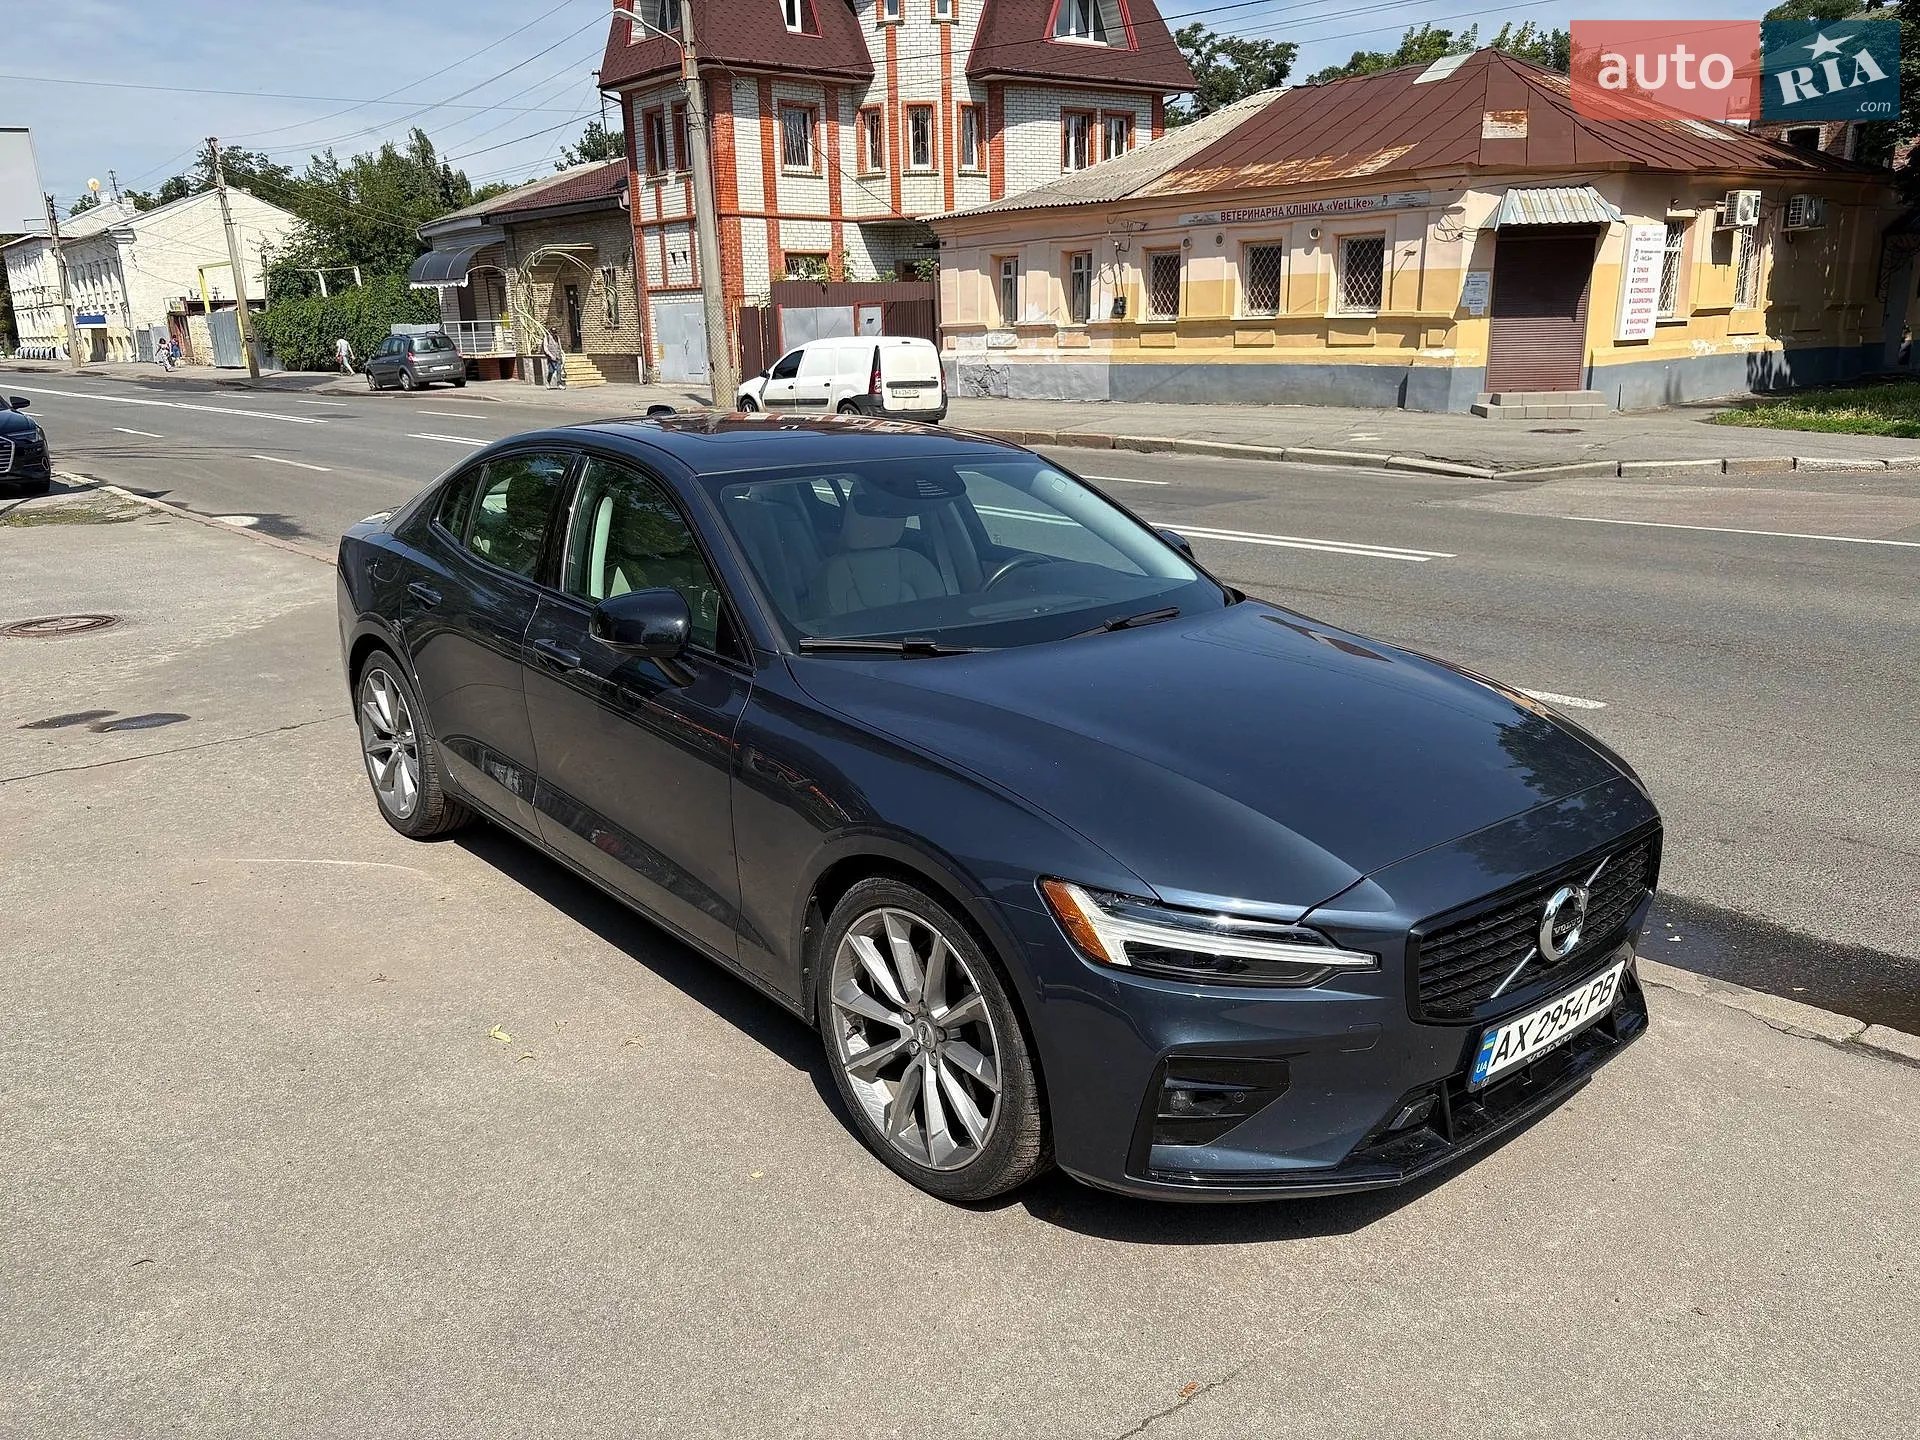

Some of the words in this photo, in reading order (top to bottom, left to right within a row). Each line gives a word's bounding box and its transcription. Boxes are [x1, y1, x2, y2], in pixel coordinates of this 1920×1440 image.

[1220, 205, 1284, 221] ВЕТЕРИНАРНА
[1286, 202, 1324, 215] КЛІНІКА
[1326, 198, 1374, 210] «VetLike»
[1492, 1018, 1535, 1066] AX
[1531, 988, 1587, 1047] 2954
[1584, 971, 1616, 1016] PB
[1526, 1032, 1573, 1064] VOLVO
[1476, 1061, 1488, 1074] UA
